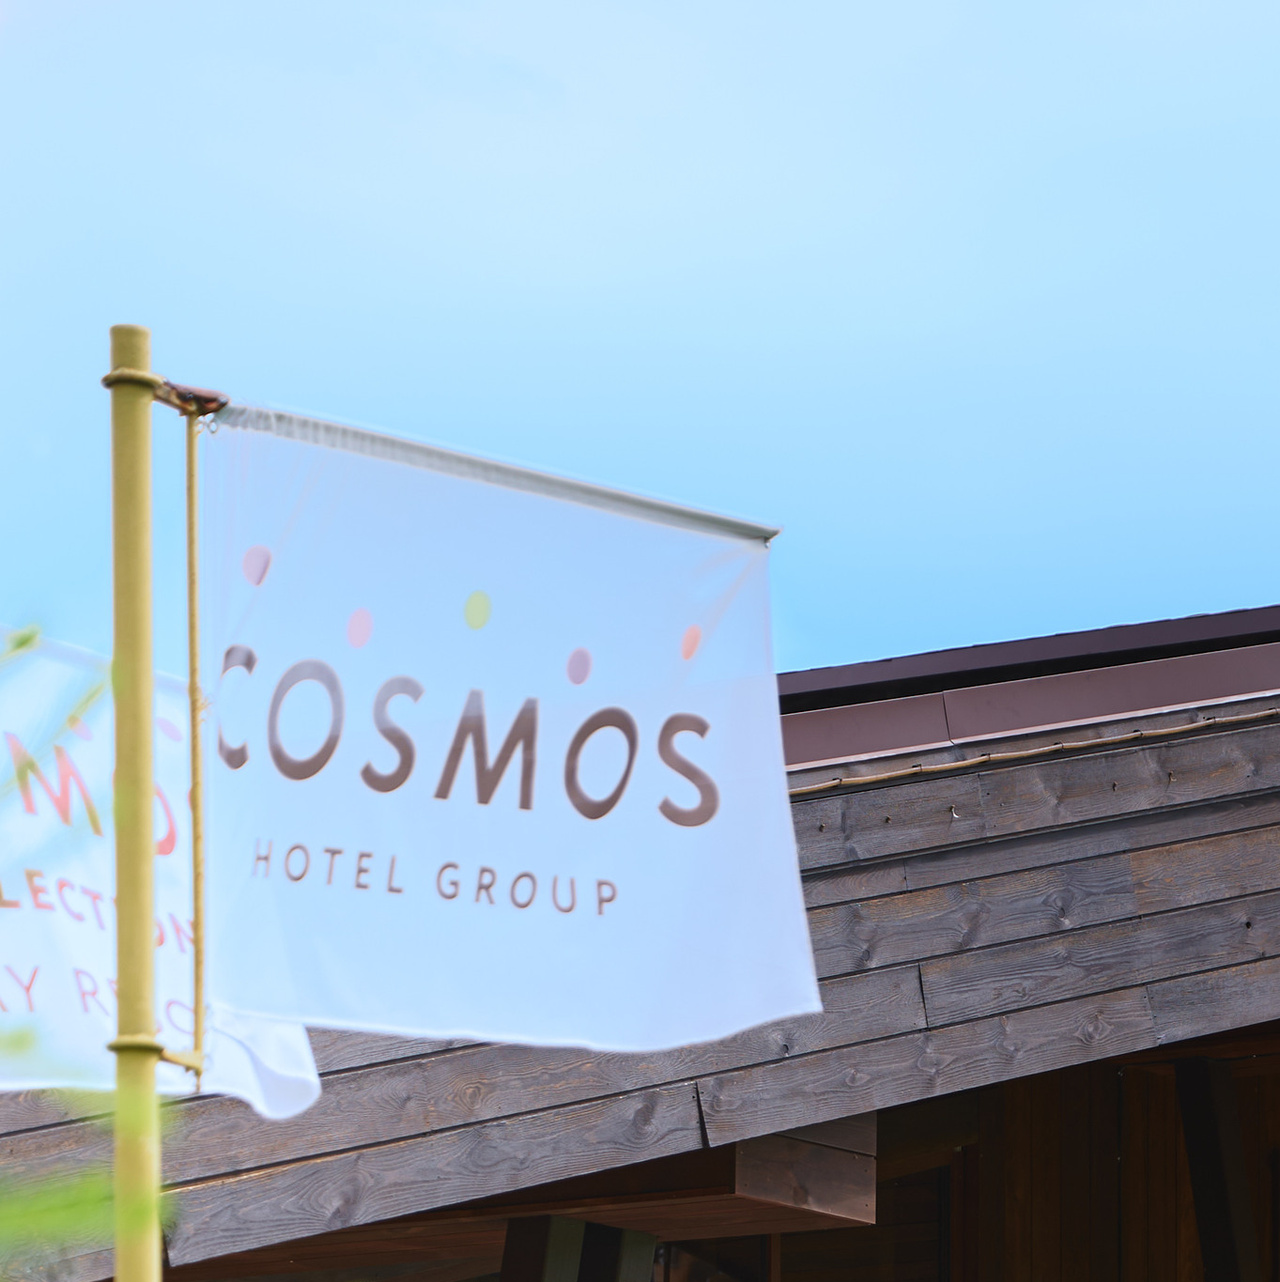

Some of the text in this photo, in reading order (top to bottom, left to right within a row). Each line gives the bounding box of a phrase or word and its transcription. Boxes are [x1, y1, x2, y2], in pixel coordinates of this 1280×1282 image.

[217, 644, 720, 828] COSMOS
[254, 838, 619, 917] HOTEL GROUP
